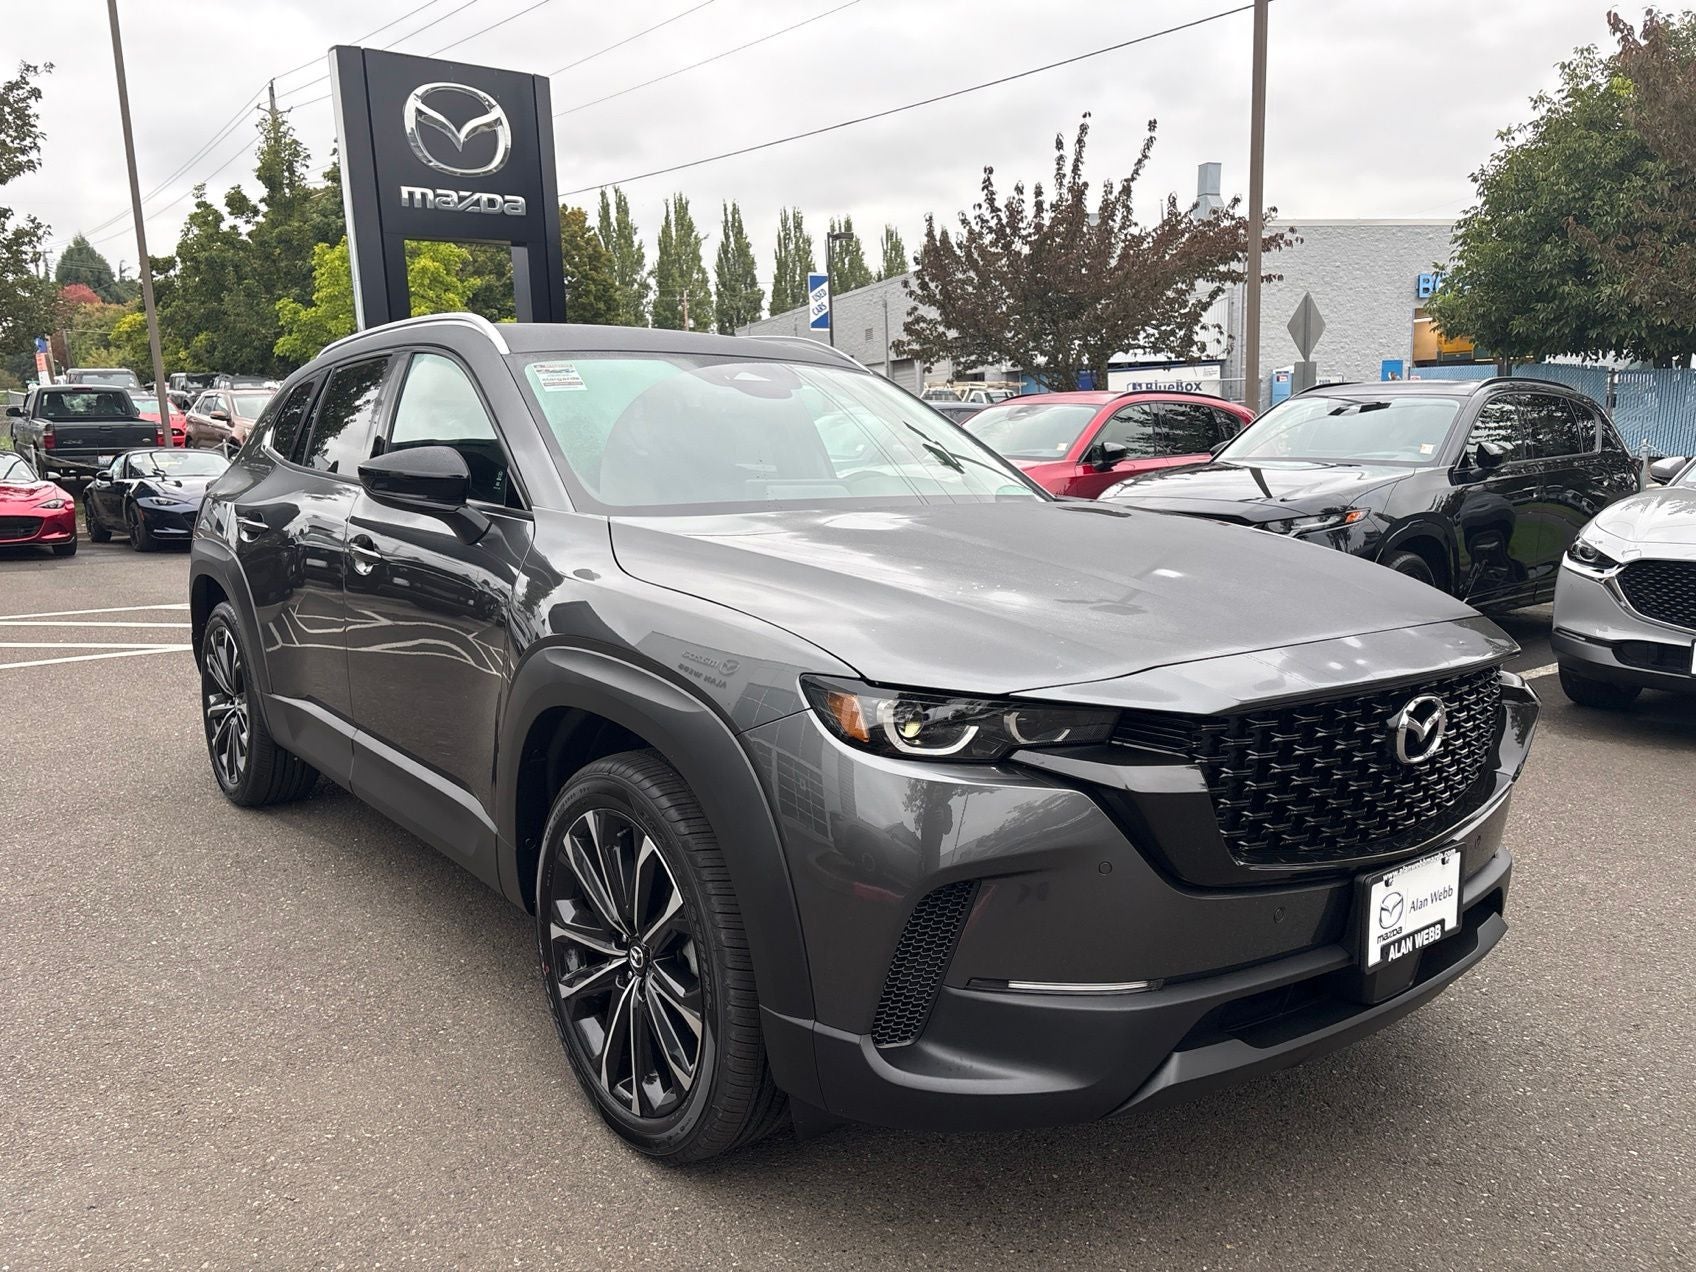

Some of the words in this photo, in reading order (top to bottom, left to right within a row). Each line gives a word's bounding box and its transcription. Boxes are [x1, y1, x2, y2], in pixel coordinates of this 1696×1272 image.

[400, 185, 527, 216] mazda
[812, 288, 827, 302] USED
[812, 302, 827, 316] CARS
[1409, 898, 1428, 913] Alan
[1430, 885, 1453, 904] Webb
[1376, 926, 1403, 945] mazda
[1388, 936, 1413, 962] ALAN
[1415, 924, 1441, 949] WEBB
